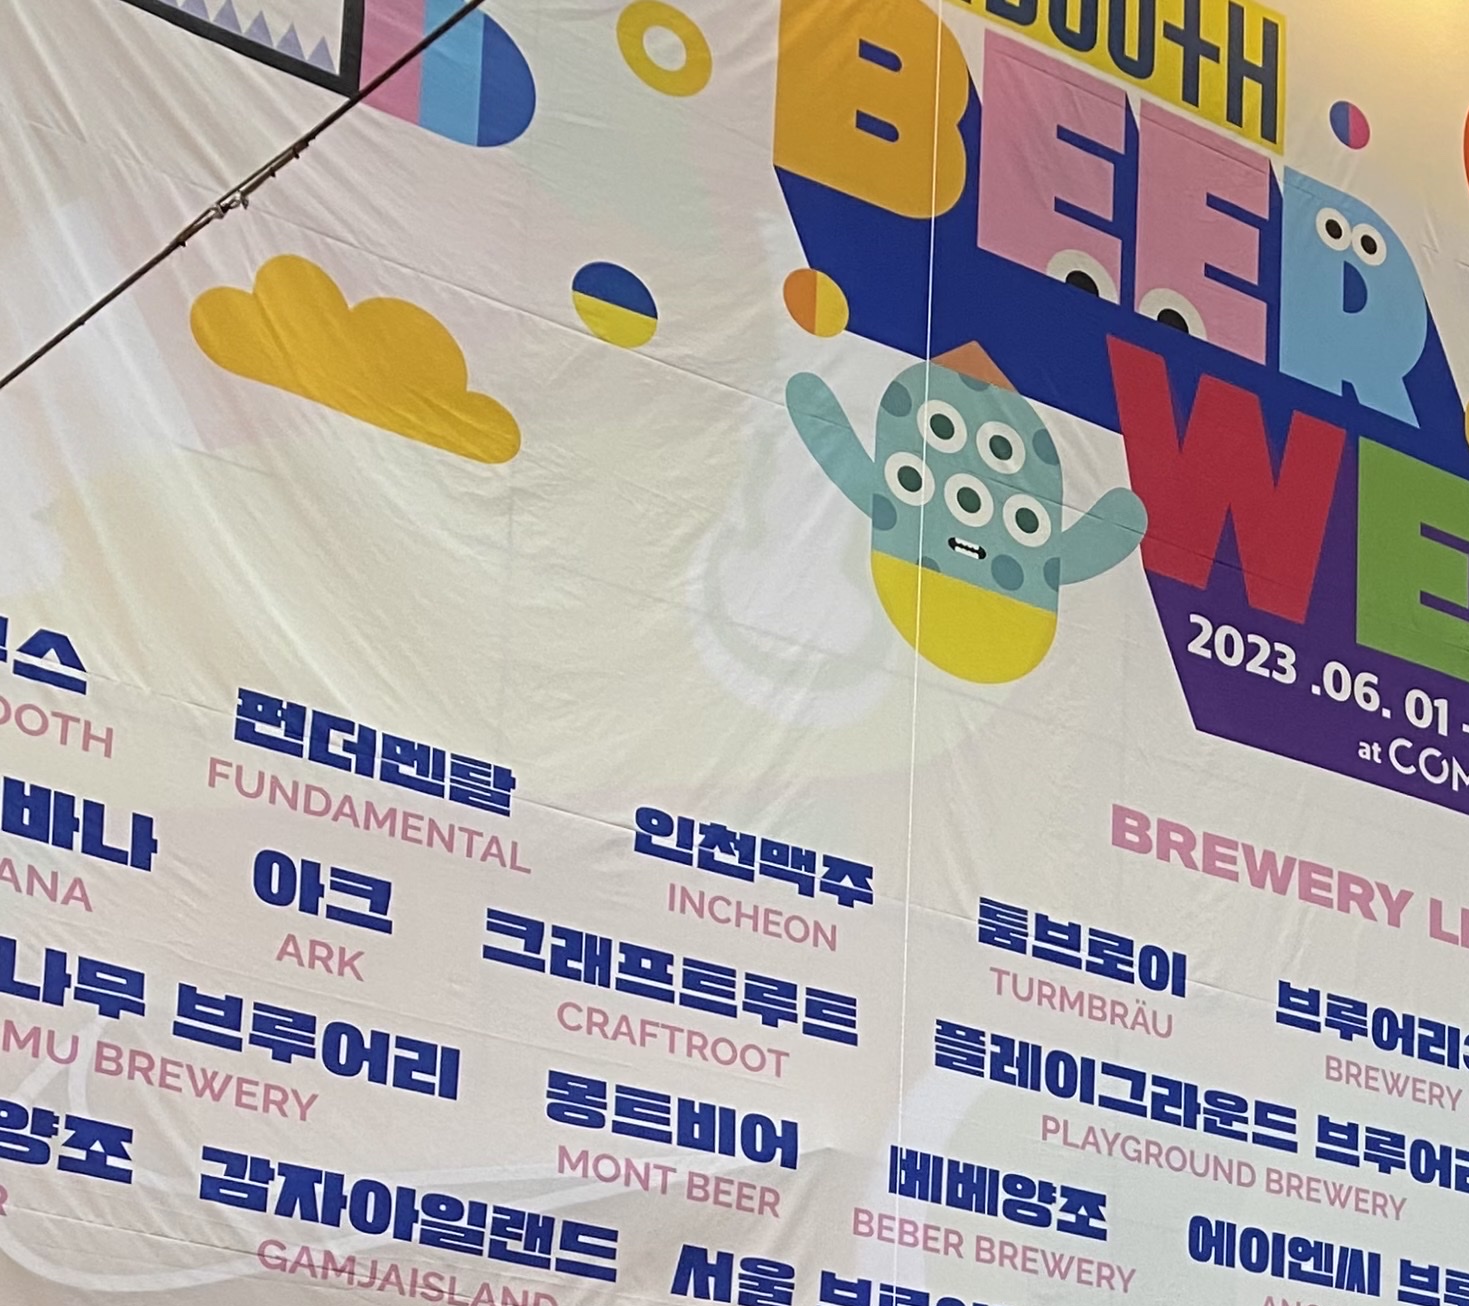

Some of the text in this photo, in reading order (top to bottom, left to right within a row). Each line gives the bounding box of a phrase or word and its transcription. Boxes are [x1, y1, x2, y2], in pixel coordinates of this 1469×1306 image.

[773, 0, 1428, 428] BEER
[1187, 612, 1297, 685] 2023
[1404, 690, 1449, 735] 01
[234, 687, 517, 818] 펀더멘탈
[1357, 738, 1382, 766] at
[1, 775, 159, 872] 바나
[207, 756, 532, 875] FUNDAMENTAL
[633, 806, 874, 909] 인천맥주
[1111, 804, 1415, 928] BREWERY
[252, 848, 393, 935] 아크
[667, 882, 838, 953] INCHEON
[275, 932, 366, 982] ARK
[482, 907, 859, 1047] 크래프트루트
[978, 896, 1187, 999] 툼브로이
[0, 935, 461, 1101] 나무 브루어리
[556, 1000, 790, 1079] CRAFTROOT
[989, 966, 1174, 1039] TURMBRÄU
[2, 1019, 320, 1122] MU BREWERY
[546, 1068, 799, 1170] 몽트비어
[934, 1017, 1299, 1154] 플레이그라운드
[1324, 1054, 1463, 1112] BREWERY
[0, 1101, 134, 1185] 양조
[556, 1144, 781, 1219] MONT BEER
[888, 1144, 1108, 1242] 베베양조
[1040, 1114, 1408, 1222] PLAYGROUND BREWERY
[199, 1144, 620, 1284] 감자아일랜드
[852, 1206, 1137, 1294] BEBER BREWERY
[1187, 1214, 1382, 1298] 에이엔씨
